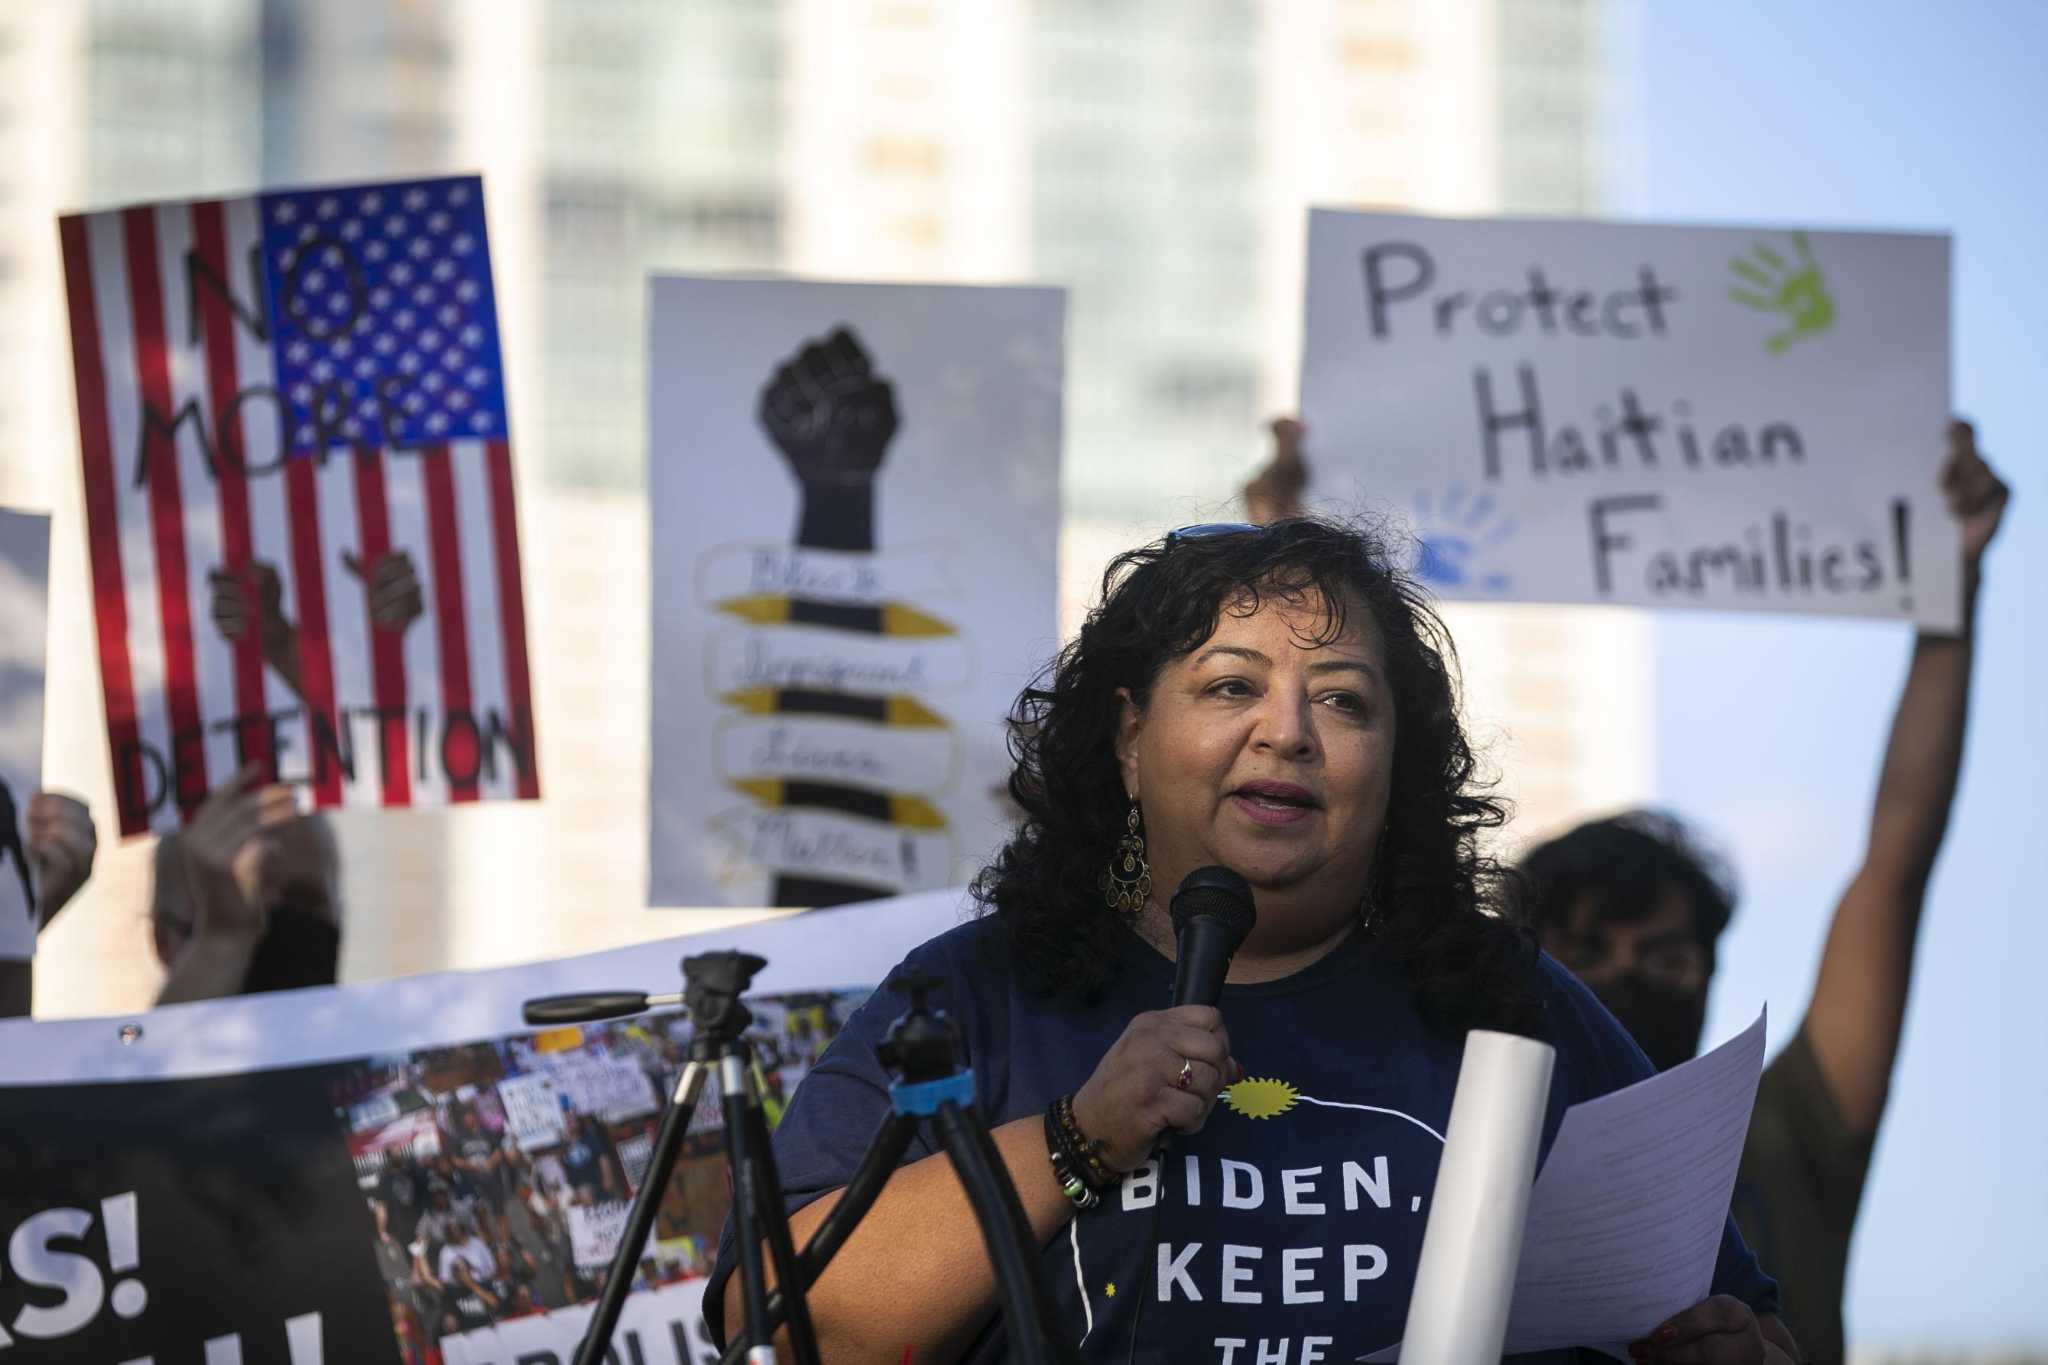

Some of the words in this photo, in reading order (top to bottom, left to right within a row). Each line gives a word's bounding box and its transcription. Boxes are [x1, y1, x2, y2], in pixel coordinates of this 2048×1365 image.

[183, 237, 366, 347] NO
[1362, 240, 1678, 342] Protect
[133, 375, 444, 490] MORE
[1473, 361, 1806, 482] Haitian
[1589, 495, 1914, 613] Families!
[118, 703, 530, 818] DETENTION
[1121, 1155, 1422, 1216] BIDEN,
[0, 1190, 148, 1348] S!
[1157, 1243, 1389, 1305] KEEP
[1214, 1336, 1334, 1365] THE
